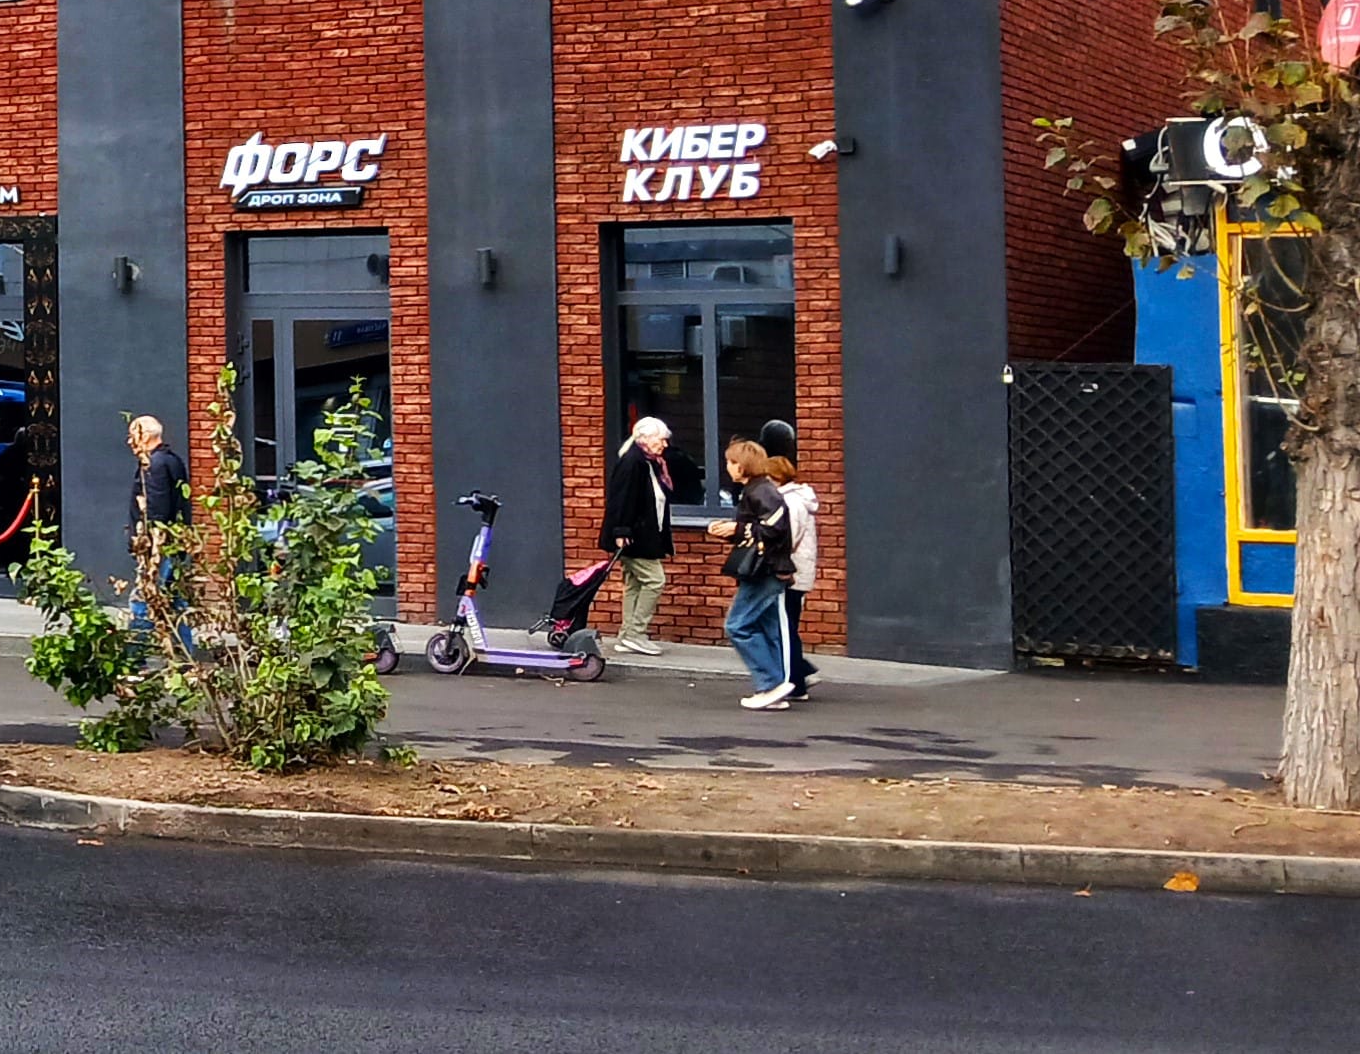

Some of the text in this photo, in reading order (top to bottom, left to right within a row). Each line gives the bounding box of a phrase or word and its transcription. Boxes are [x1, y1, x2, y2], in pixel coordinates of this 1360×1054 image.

[620, 123, 767, 162] КИБЕР
[219, 131, 387, 197] ФОРС
[622, 162, 761, 202] КЛУБ
[247, 192, 343, 207] ДРОП ЗОНА
